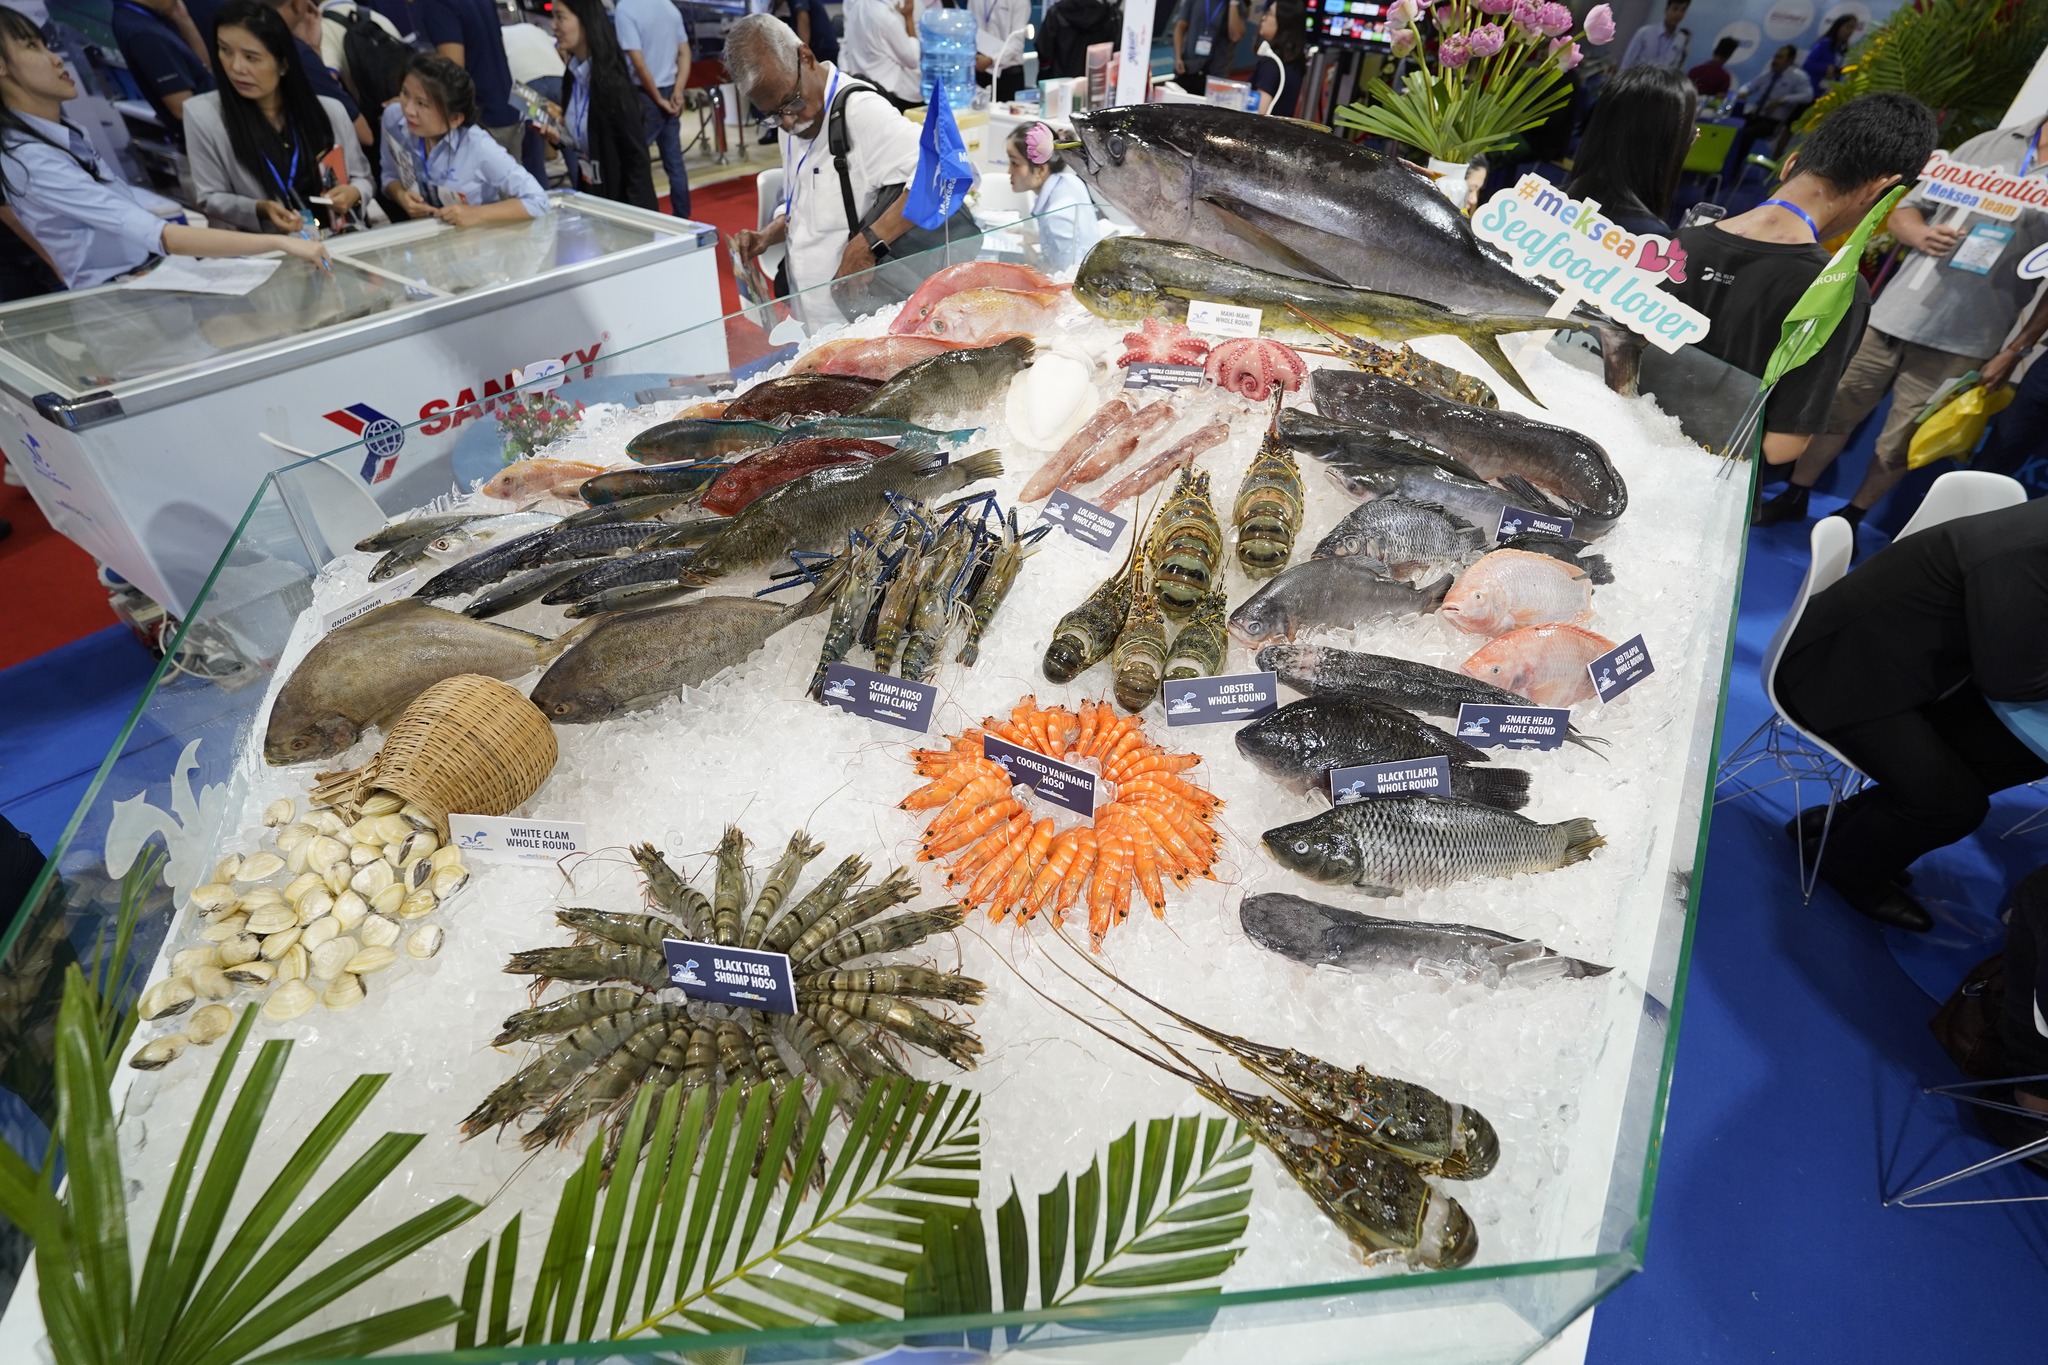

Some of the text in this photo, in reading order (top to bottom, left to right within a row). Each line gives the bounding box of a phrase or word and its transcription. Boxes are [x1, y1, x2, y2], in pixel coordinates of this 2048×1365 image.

[1919, 154, 2048, 208] Conscientio
[1926, 182, 2018, 217] Meksea team
[1517, 179, 1636, 260] #meksea
[1481, 199, 1699, 341] Seafood lover
[1215, 317, 1234, 325] WHOLE
[1234, 319, 1253, 327] ROUND
[1220, 310, 1251, 319] MAHI-MAHI
[1072, 513, 1092, 528] WHOLE
[1091, 523, 1112, 537] ROUND
[1077, 507, 1098, 521] LOLIGO
[1097, 516, 1115, 530] SQUID
[1532, 520, 1562, 533] PANGASIUS
[358, 599, 381, 614] WHOLE
[332, 611, 357, 628] ROUND
[1614, 645, 1640, 666] RED TILAPIA
[1615, 660, 1632, 676] WHOLE
[1630, 652, 1645, 667] ROUND
[869, 680, 899, 696] SCAMPI
[900, 688, 922, 702] HOSO
[1219, 683, 1254, 694] LOBSTER
[869, 691, 889, 705] WITH
[890, 697, 918, 712] CLAWS
[1208, 692, 1267, 706] WHOLE ROUND
[1505, 715, 1554, 725] SNAKE HEAD
[1499, 724, 1527, 734] WHOLE
[1527, 726, 1556, 735] ROUND
[1016, 756, 1092, 791] COOKED VANNAMEI
[1377, 767, 1438, 783] BLACK TILAPIA
[1042, 775, 1065, 790] HOSO
[1377, 778, 1439, 794] WHOLE ROUND
[510, 828, 570, 840] WHITE CLAM
[505, 838, 576, 851] WHOLE ROUND
[713, 958, 771, 977] BLACK TIGER
[714, 971, 777, 990] SHRIMP HOSO
